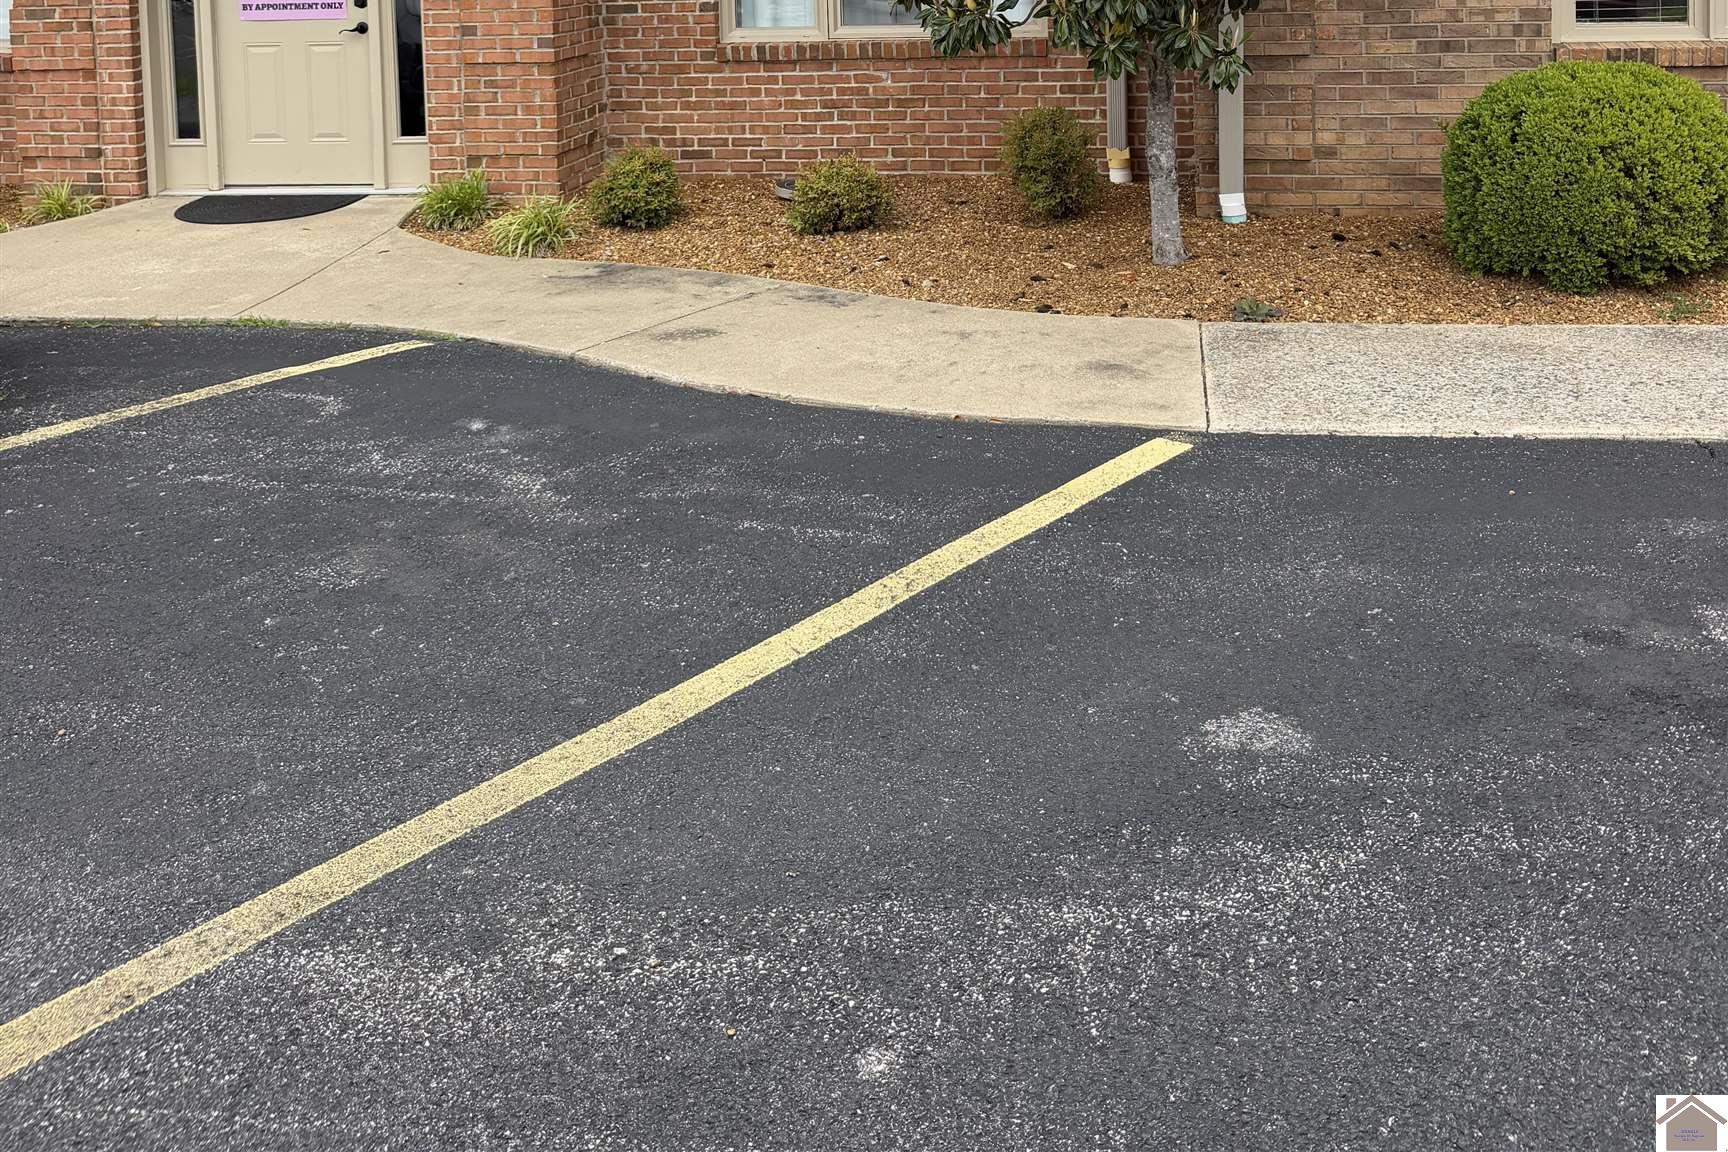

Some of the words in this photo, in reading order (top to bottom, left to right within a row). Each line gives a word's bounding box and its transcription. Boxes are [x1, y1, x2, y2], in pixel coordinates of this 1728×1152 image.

[242, 3, 253, 11] BY
[255, 2, 319, 11] APPOINTMENT
[320, 1, 344, 10] ONLY
